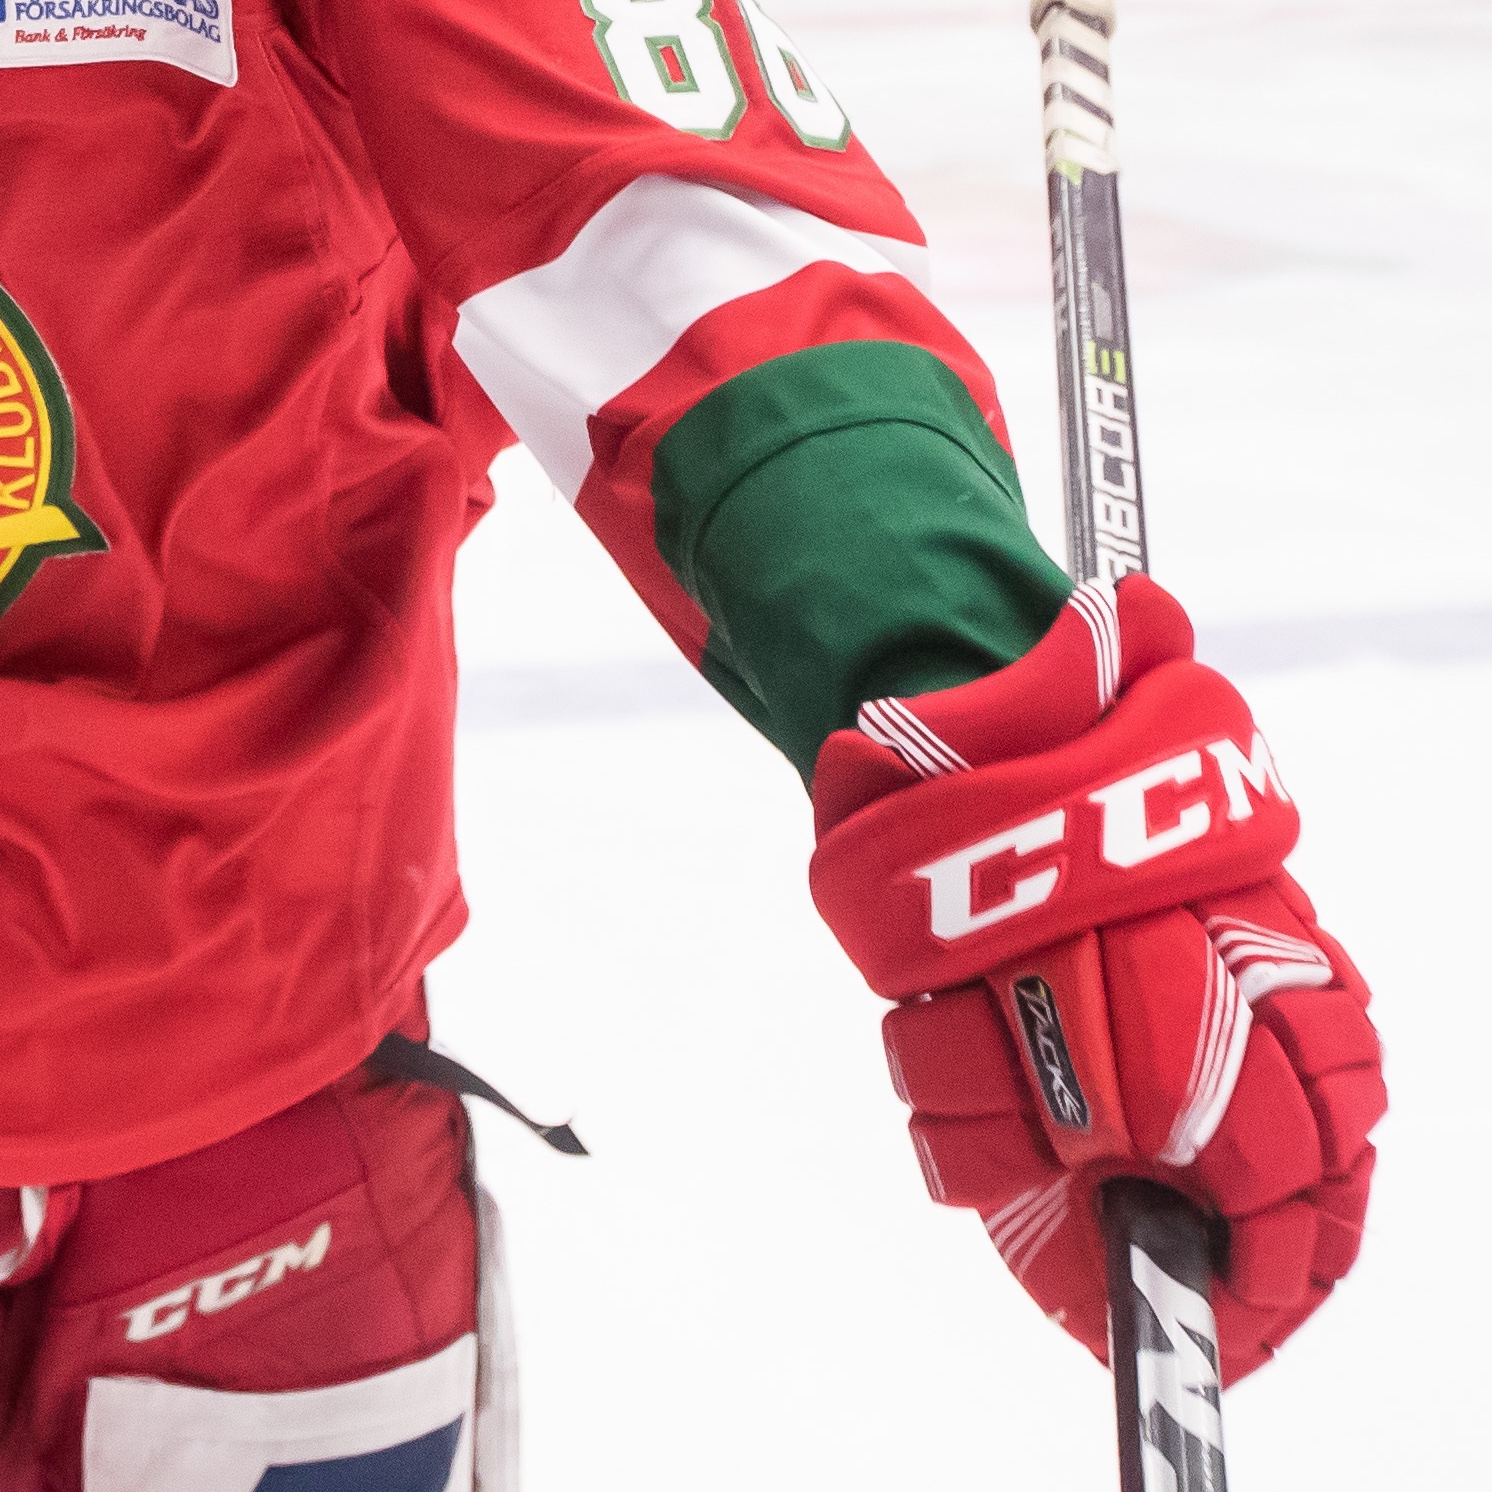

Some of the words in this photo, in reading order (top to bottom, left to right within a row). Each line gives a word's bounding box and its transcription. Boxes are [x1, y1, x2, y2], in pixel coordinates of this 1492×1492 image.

[14, 26, 50, 44] Bank
[54, 27, 69, 43] &
[909, 730, 1291, 944] CCM
[119, 1221, 332, 1344] CCM
